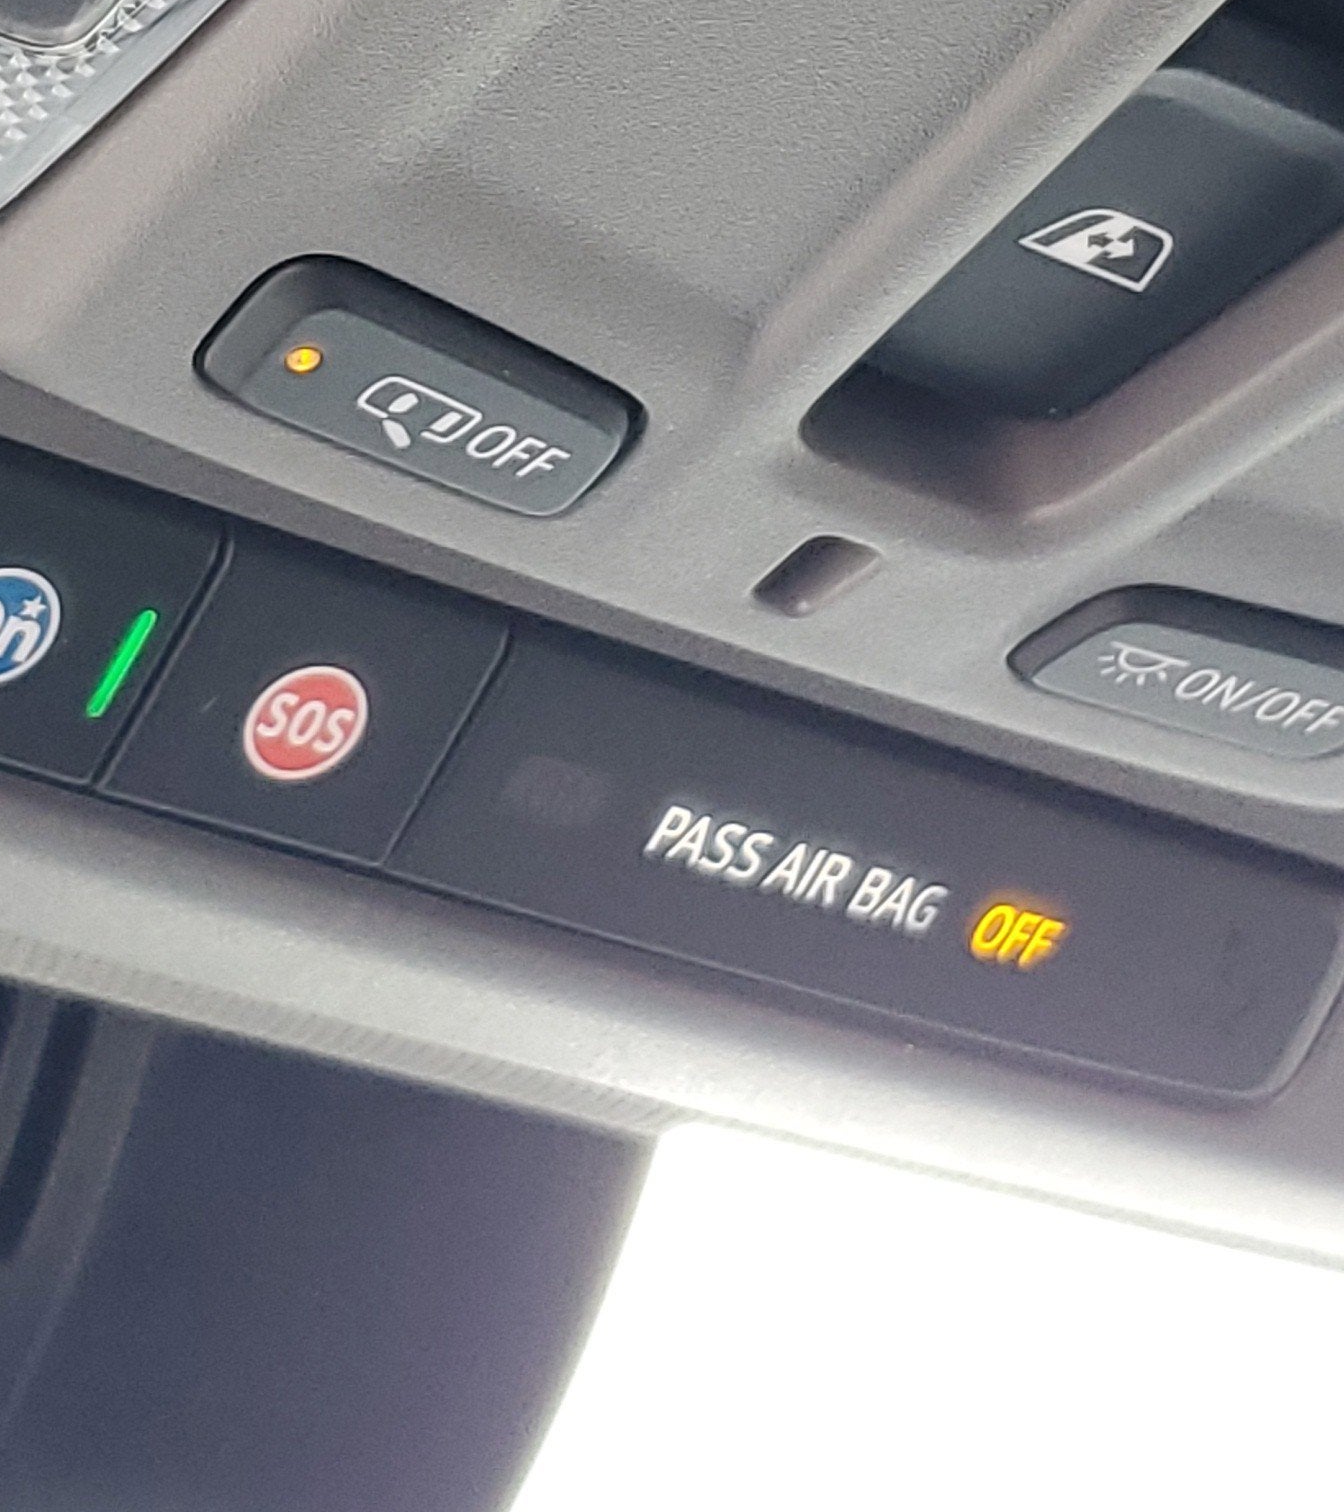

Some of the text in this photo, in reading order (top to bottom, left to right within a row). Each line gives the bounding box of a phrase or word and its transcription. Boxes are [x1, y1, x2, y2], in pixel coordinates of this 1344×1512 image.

[464, 424, 571, 478] OFF
[256, 691, 353, 755] SOS
[644, 805, 1065, 965] PASS AIR BAG OFF
